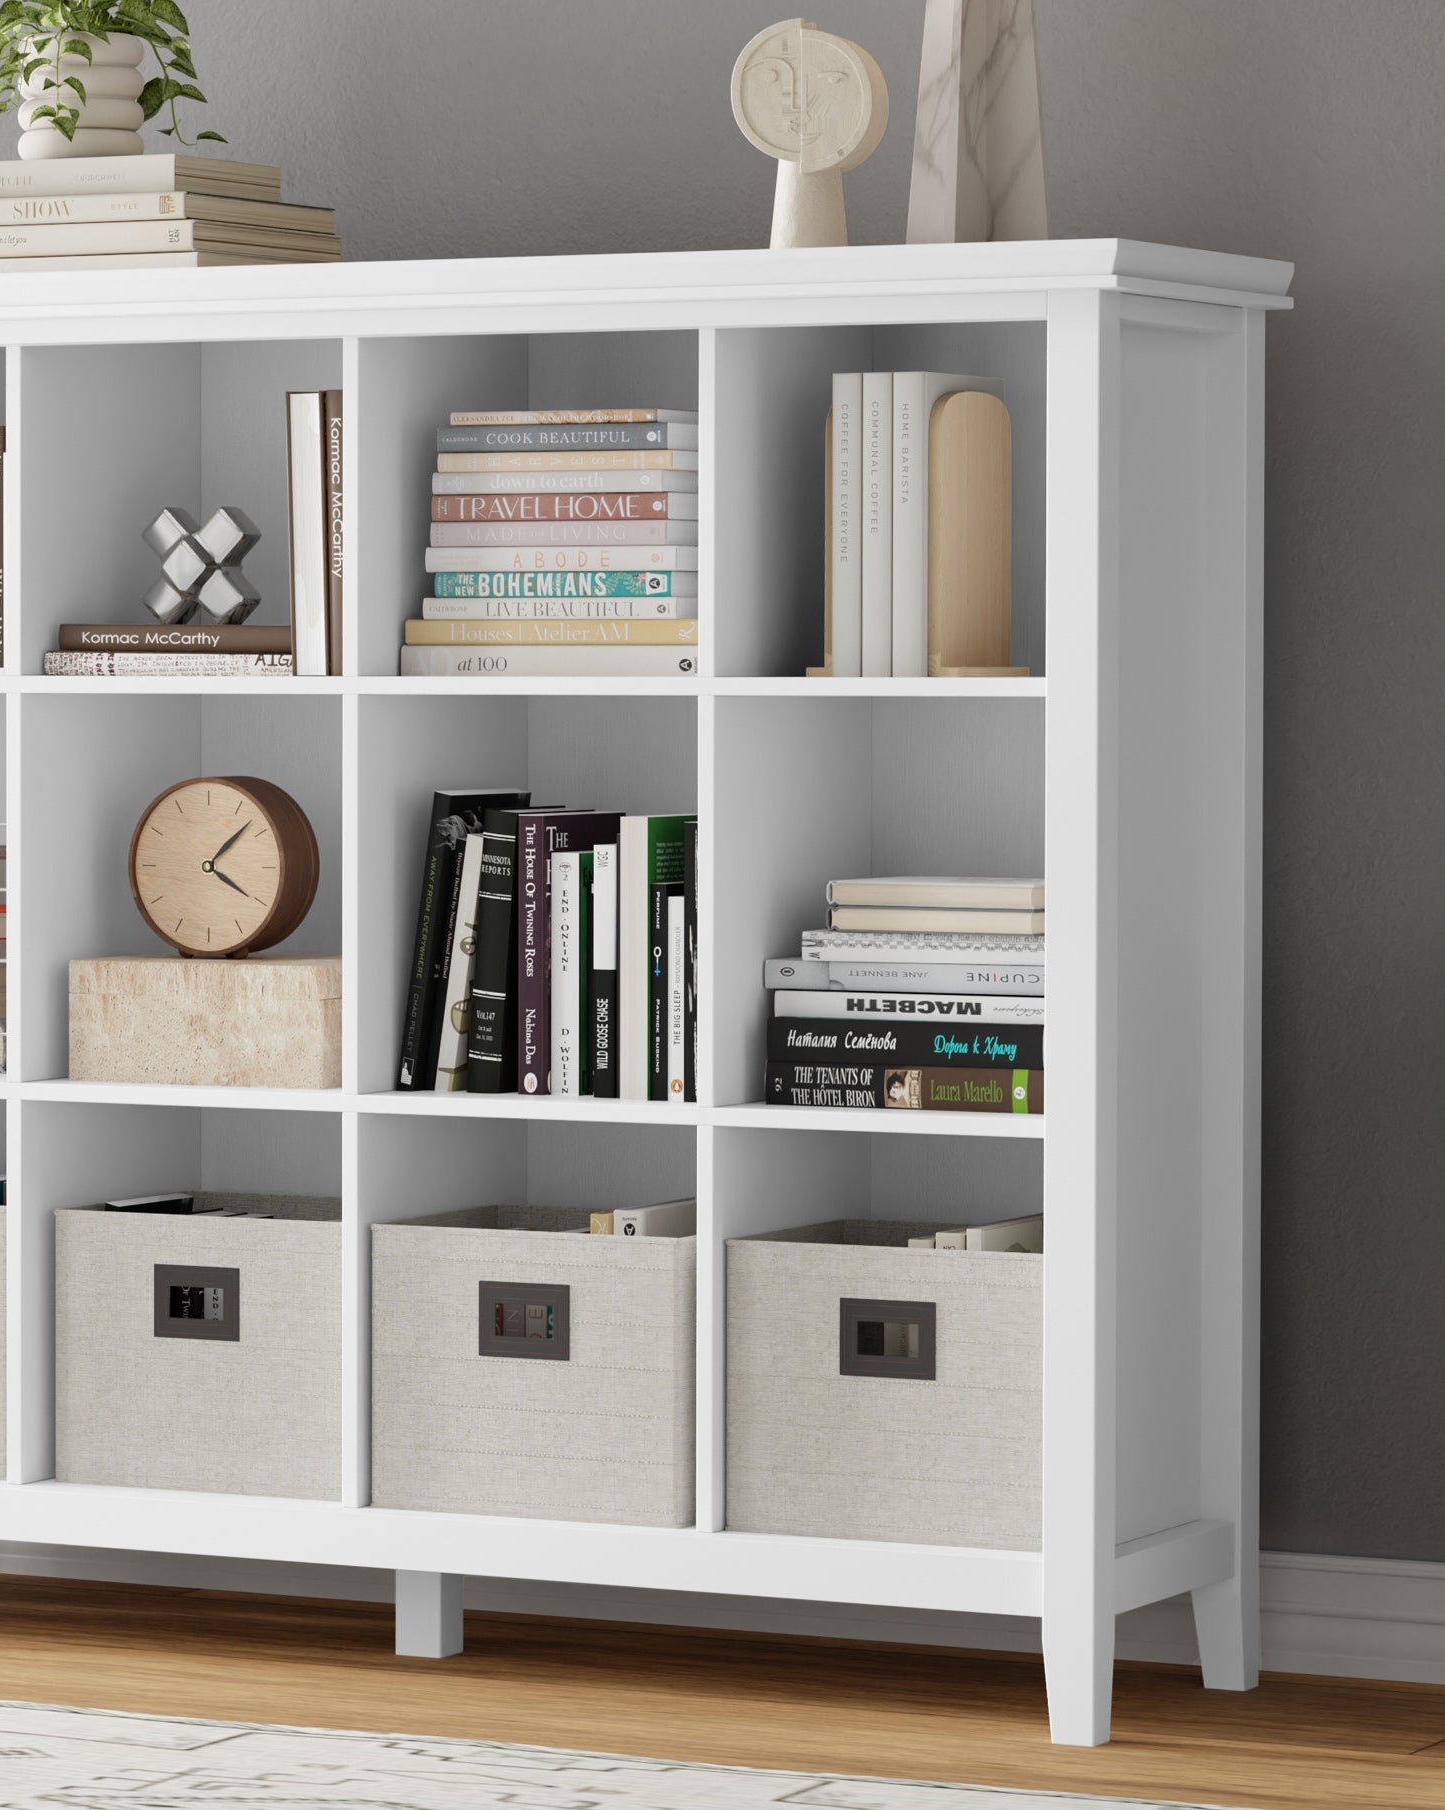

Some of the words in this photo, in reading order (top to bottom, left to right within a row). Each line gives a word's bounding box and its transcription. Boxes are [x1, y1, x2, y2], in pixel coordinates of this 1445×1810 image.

[12, 200, 74, 219] SHOW
[840, 403, 849, 454] COFFEE
[901, 403, 910, 440] HOME
[486, 432, 533, 445] COOK
[539, 430, 631, 444] BEAUTIFUL
[870, 401, 880, 476] COMMUNAL
[331, 417, 342, 485] Kormac
[487, 454, 626, 468] HARVEST
[491, 473, 536, 490] down
[539, 474, 556, 489] to
[559, 471, 605, 489] earth
[840, 460, 849, 487] FOR
[900, 447, 910, 505] BARISTA
[454, 496, 548, 520] TRAVEL
[554, 494, 641, 519] HOME
[869, 483, 879, 534] COFFEE
[332, 491, 343, 579] McCarthy
[466, 527, 529, 542] MADE
[549, 524, 627, 542] LIVING
[839, 494, 850, 564] EVERYONE
[512, 550, 611, 569] ABODE
[454, 585, 475, 597] NEW
[477, 571, 607, 598] BOHEMIANS
[458, 573, 475, 585] THE
[485, 601, 528, 617] LIVE
[533, 600, 641, 618] BEAUTIFUL
[81, 631, 140, 645] Kormac
[145, 631, 220, 648] McCarthy
[450, 623, 514, 642] Houses
[528, 622, 590, 642] Atelier
[593, 622, 630, 641] AM
[457, 656, 473, 672] at
[477, 655, 508, 672] 100
[525, 824, 536, 846] THE
[428, 856, 437, 881] AWAY
[525, 848, 536, 880] HOUSE
[597, 851, 608, 868] WGC
[425, 883, 434, 912] FROM
[525, 882, 536, 899] OF
[525, 901, 536, 946] TWINING
[416, 915, 431, 980] EVERYWHERE
[525, 948, 536, 978] ROSES
[848, 970, 898, 979] BENNETT
[901, 971, 930, 980] JANE
[411, 993, 420, 1018] CHAD
[596, 998, 608, 1023] CHASE
[673, 989, 681, 1013] SLEEP
[846, 998, 982, 1016] MACBETH
[525, 1008, 537, 1045] Nabina
[673, 1014, 681, 1028] BIG
[596, 1024, 608, 1049] GOOSE
[673, 1030, 681, 1046] THE
[786, 1028, 838, 1048] Наталия
[844, 1030, 898, 1051] Семёнова
[525, 1045, 536, 1065] Das
[596, 1050, 608, 1070] WILD
[774, 1077, 783, 1093] 92
[793, 1065, 815, 1084] THE
[815, 1066, 860, 1086] TENANTS
[860, 1067, 875, 1086] OF
[930, 1079, 961, 1102] Laura
[964, 1079, 1004, 1103] Marello
[791, 1087, 812, 1106] THE
[812, 1084, 845, 1107] HÔTEL
[845, 1089, 877, 1109] BIRON
